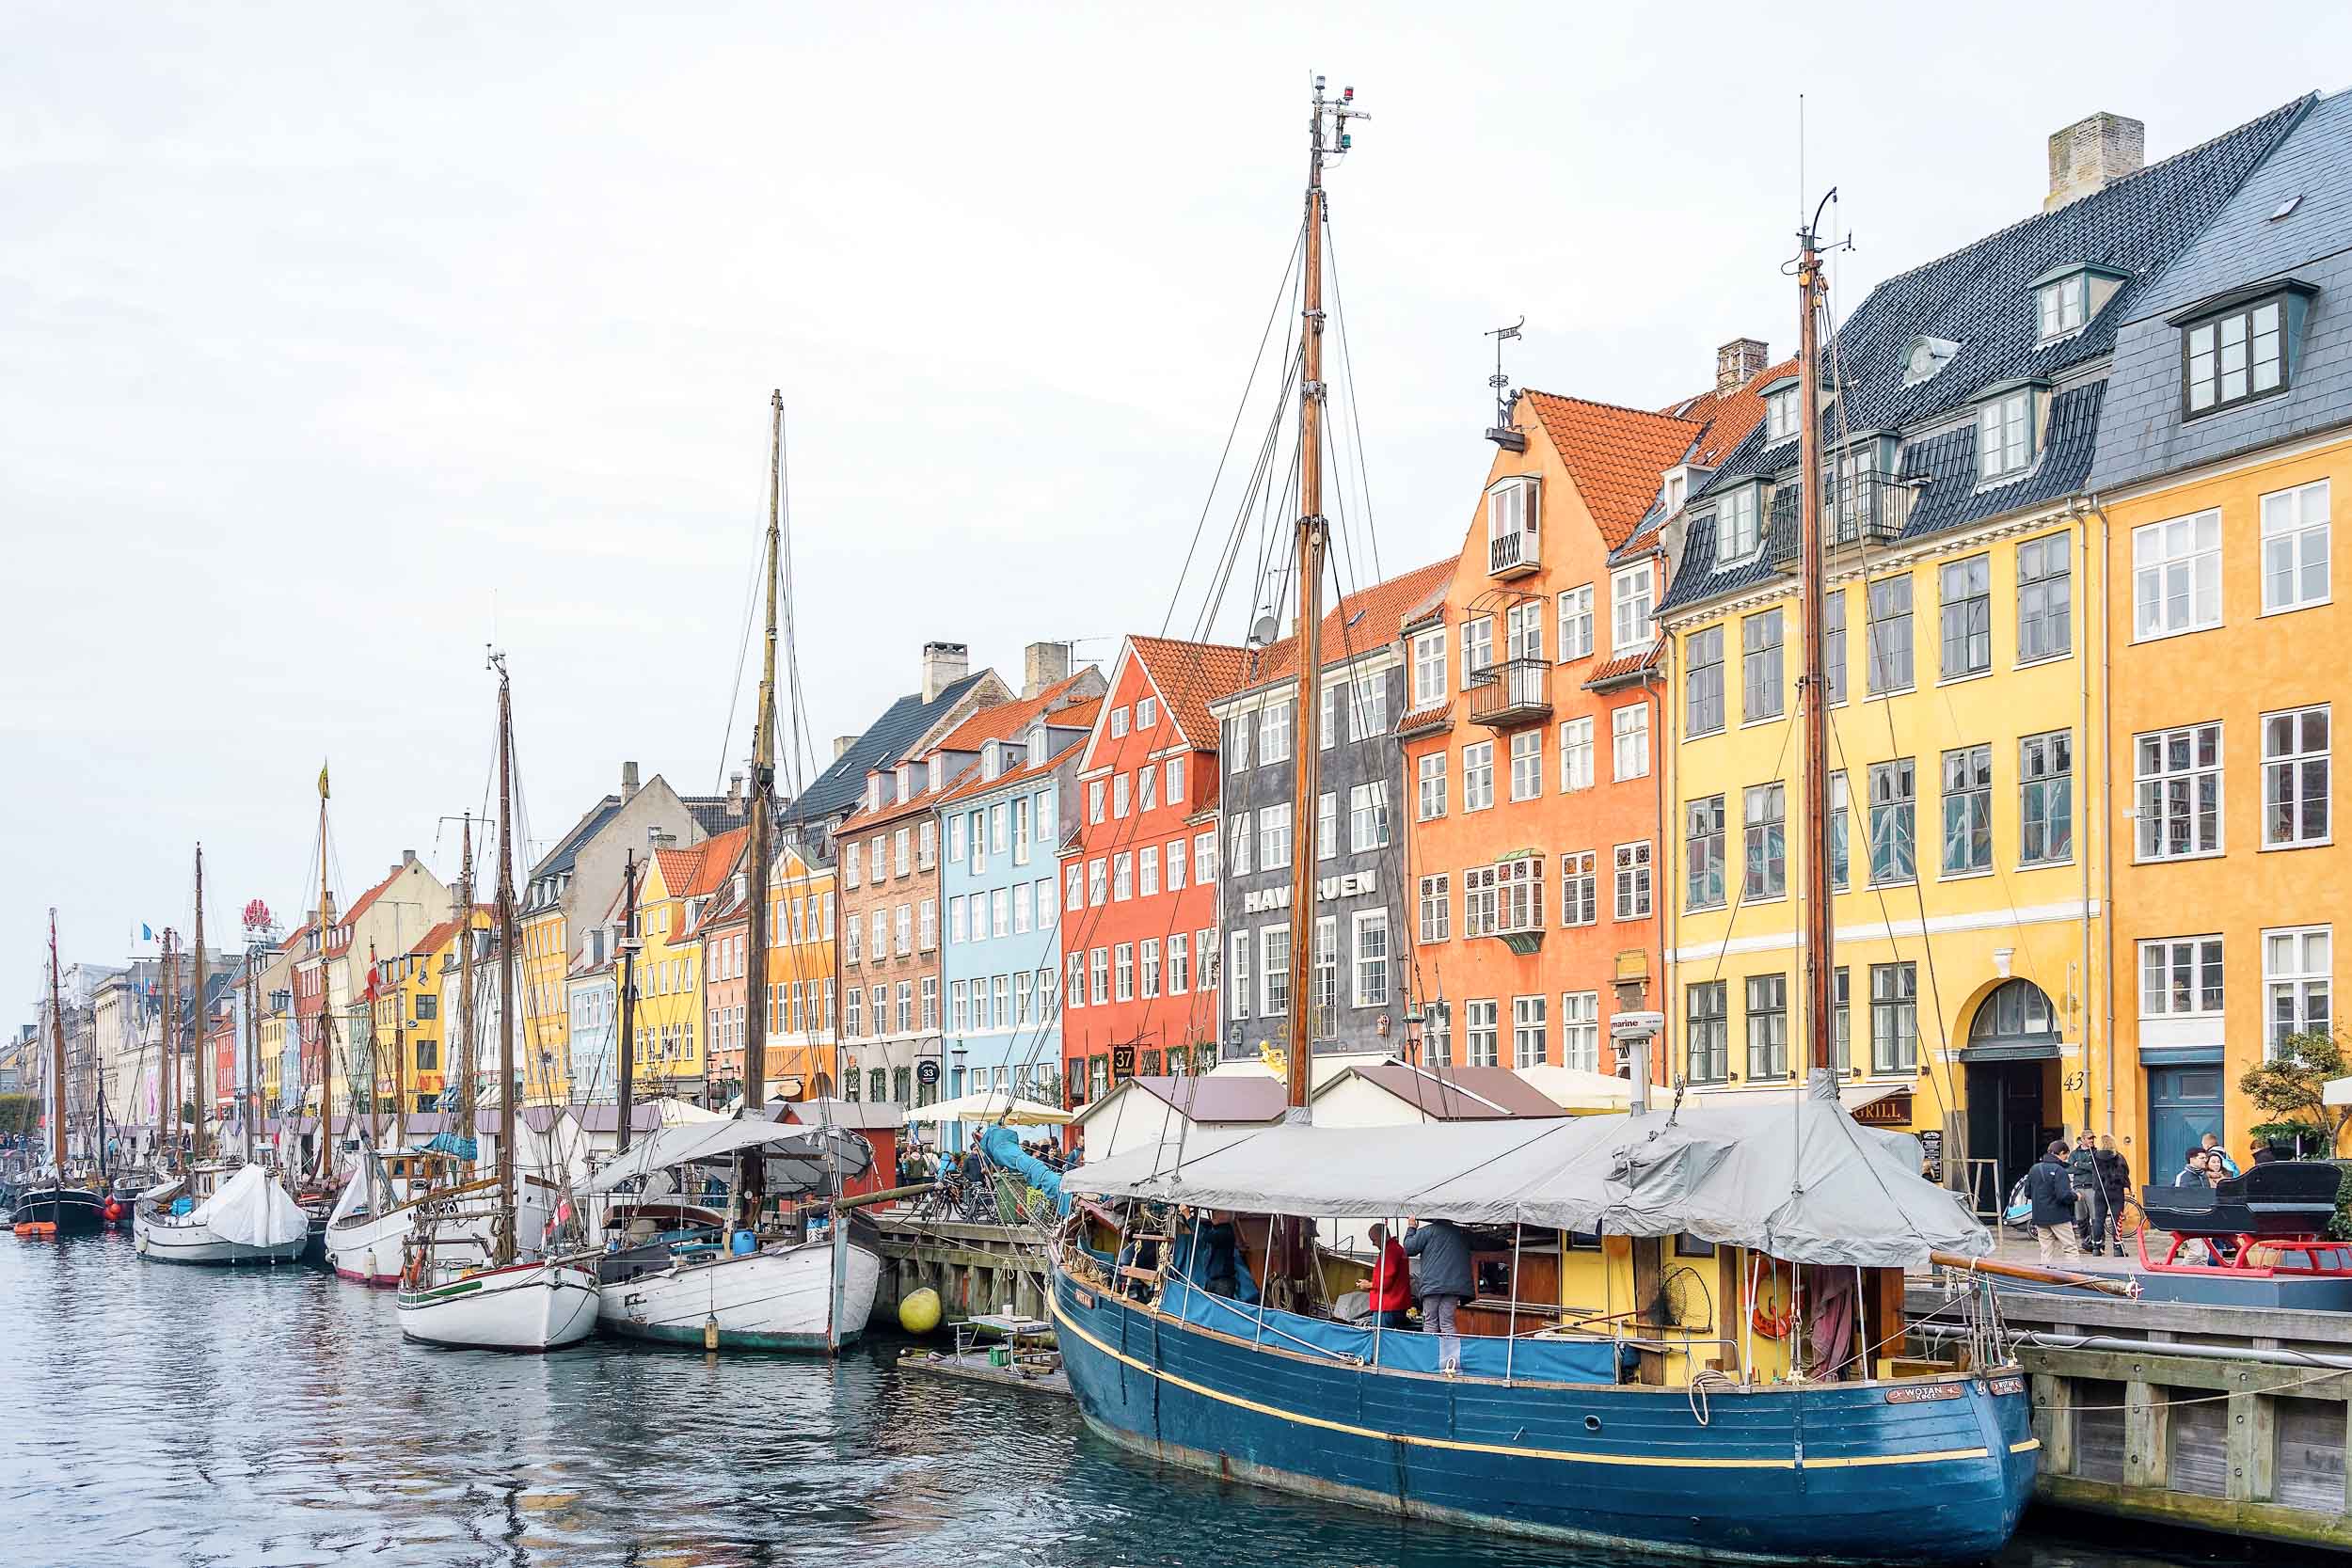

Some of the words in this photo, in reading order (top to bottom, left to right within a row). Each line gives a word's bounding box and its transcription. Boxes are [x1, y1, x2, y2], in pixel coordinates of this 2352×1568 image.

[1116, 1051, 1133, 1068] 37
[923, 1069, 934, 1077] 33
[2063, 1071, 2084, 1091] 43
[1905, 1386, 1943, 1396] WOTAN
